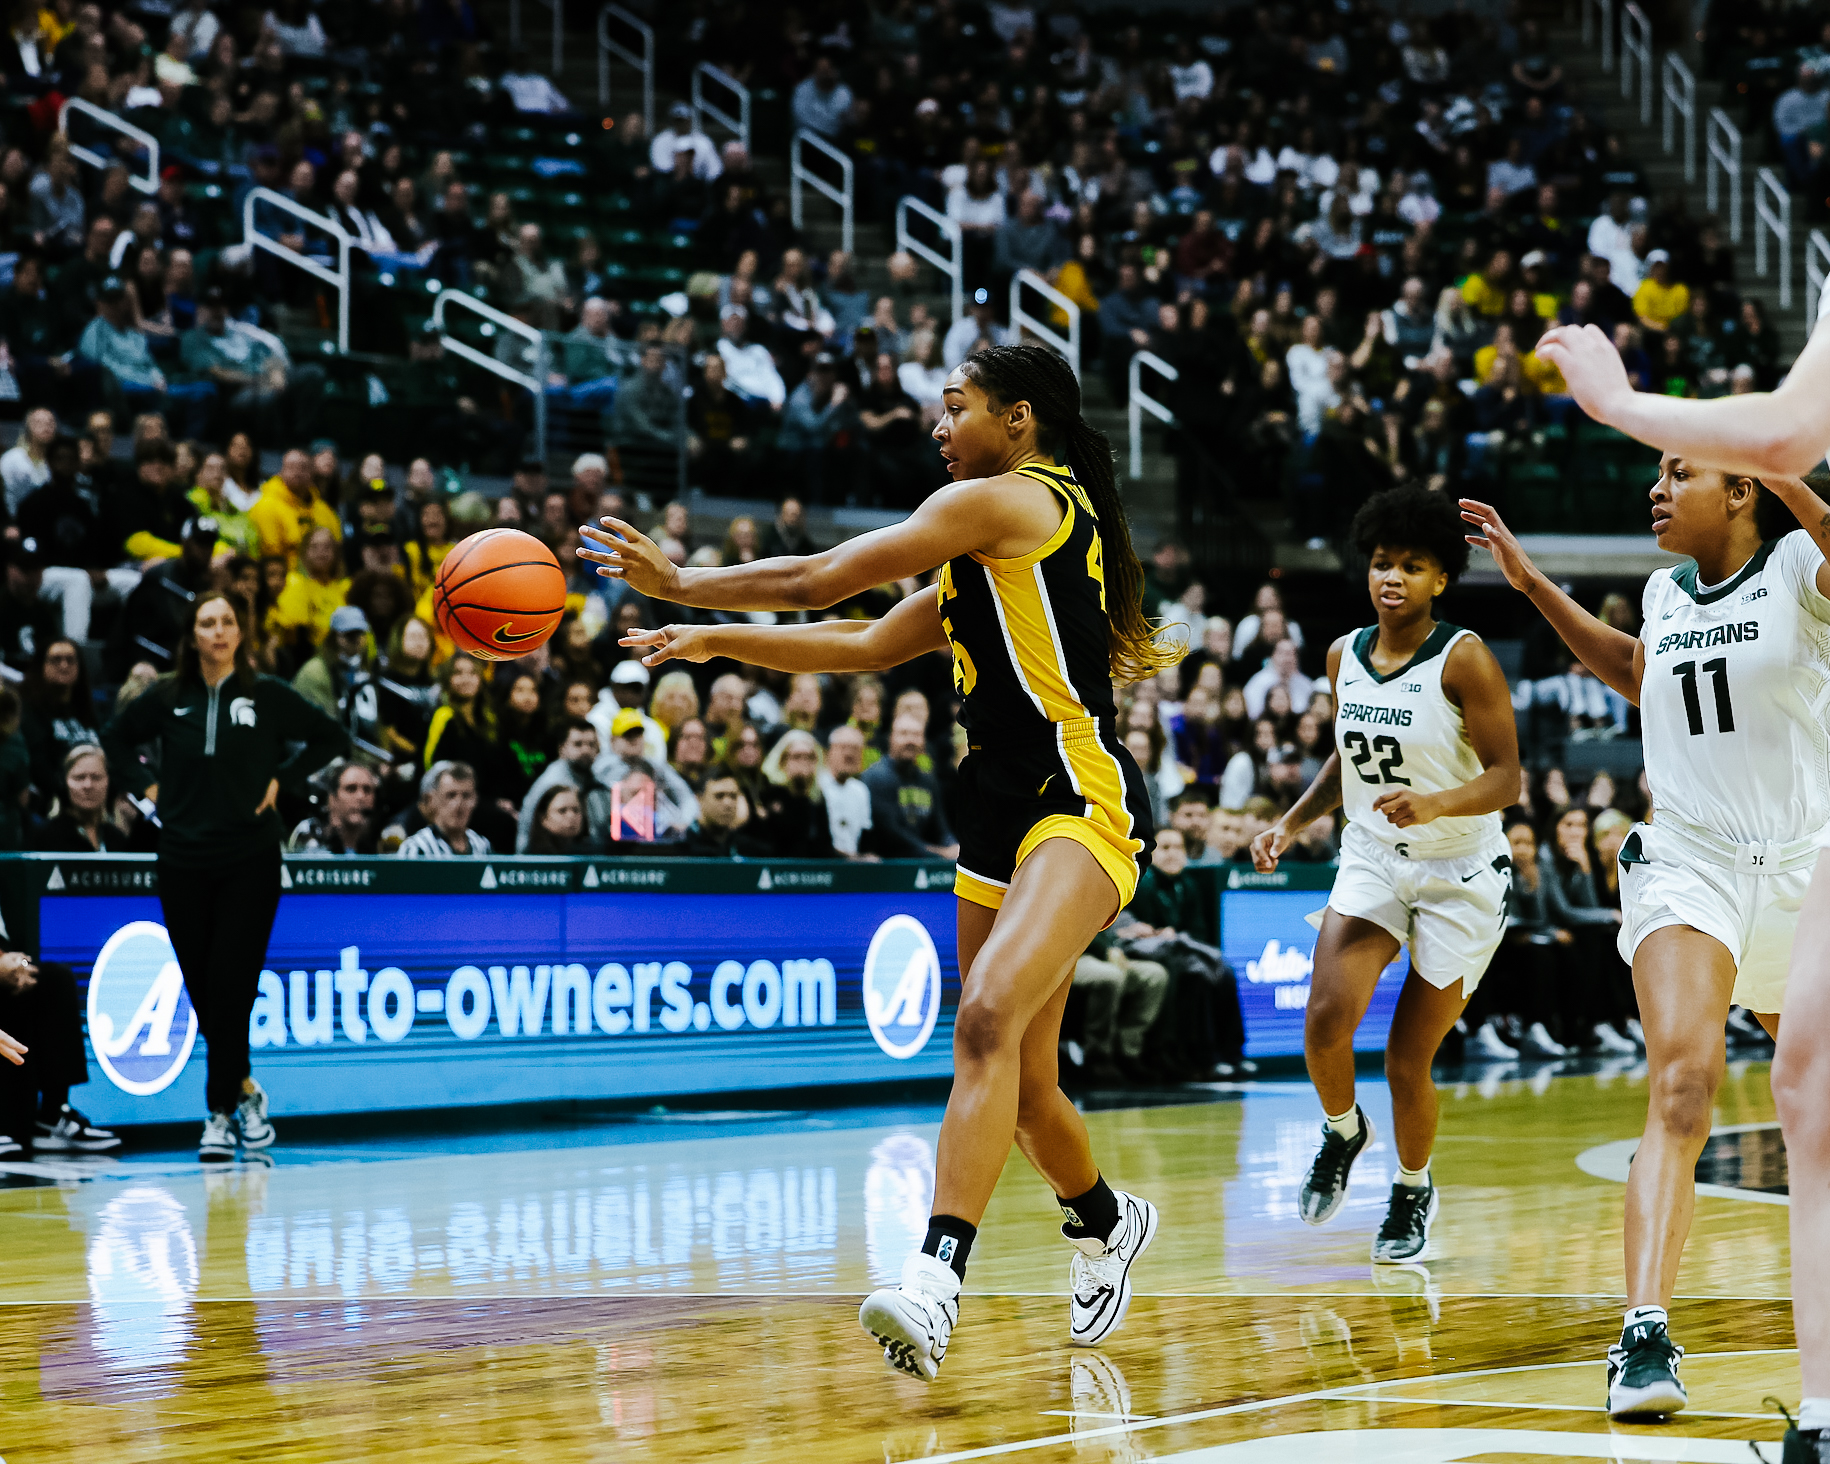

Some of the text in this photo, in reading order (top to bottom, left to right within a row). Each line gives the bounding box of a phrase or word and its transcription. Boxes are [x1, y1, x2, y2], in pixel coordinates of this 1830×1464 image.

[1656, 621, 1759, 655] SPARTANS
[1672, 657, 1735, 736] 11
[1341, 703, 1413, 726] SPARTANS
[1344, 730, 1411, 787] 22
[70, 870, 153, 887] ACRISURE
[295, 869, 371, 886] ACRISURE
[249, 945, 837, 1048] auto-owners.com
